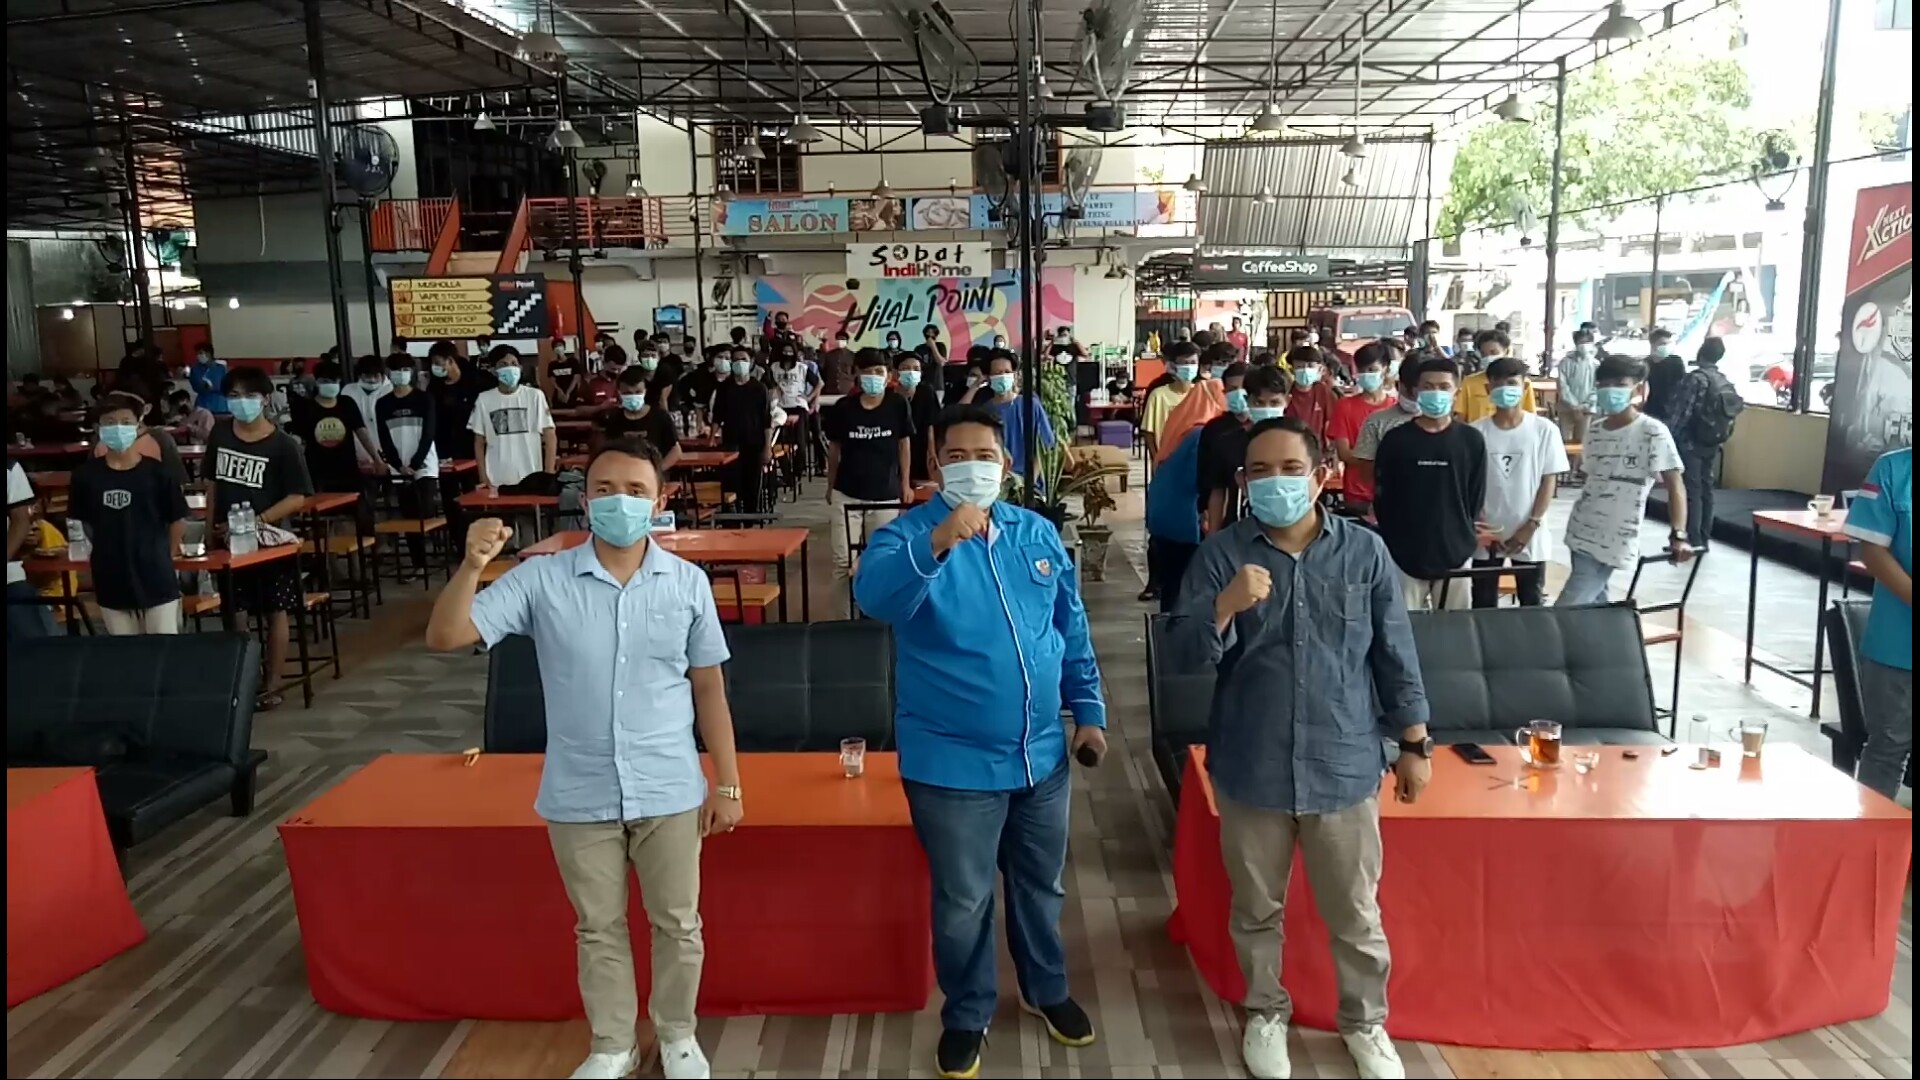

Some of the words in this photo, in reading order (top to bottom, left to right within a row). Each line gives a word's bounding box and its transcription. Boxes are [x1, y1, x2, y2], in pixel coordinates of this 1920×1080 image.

[747, 213, 839, 233] SALON
[868, 243, 964, 266] Sobat
[884, 261, 972, 278] IndiHome
[421, 304, 455, 312] MEETING
[105, 491, 129, 506] DEUS
